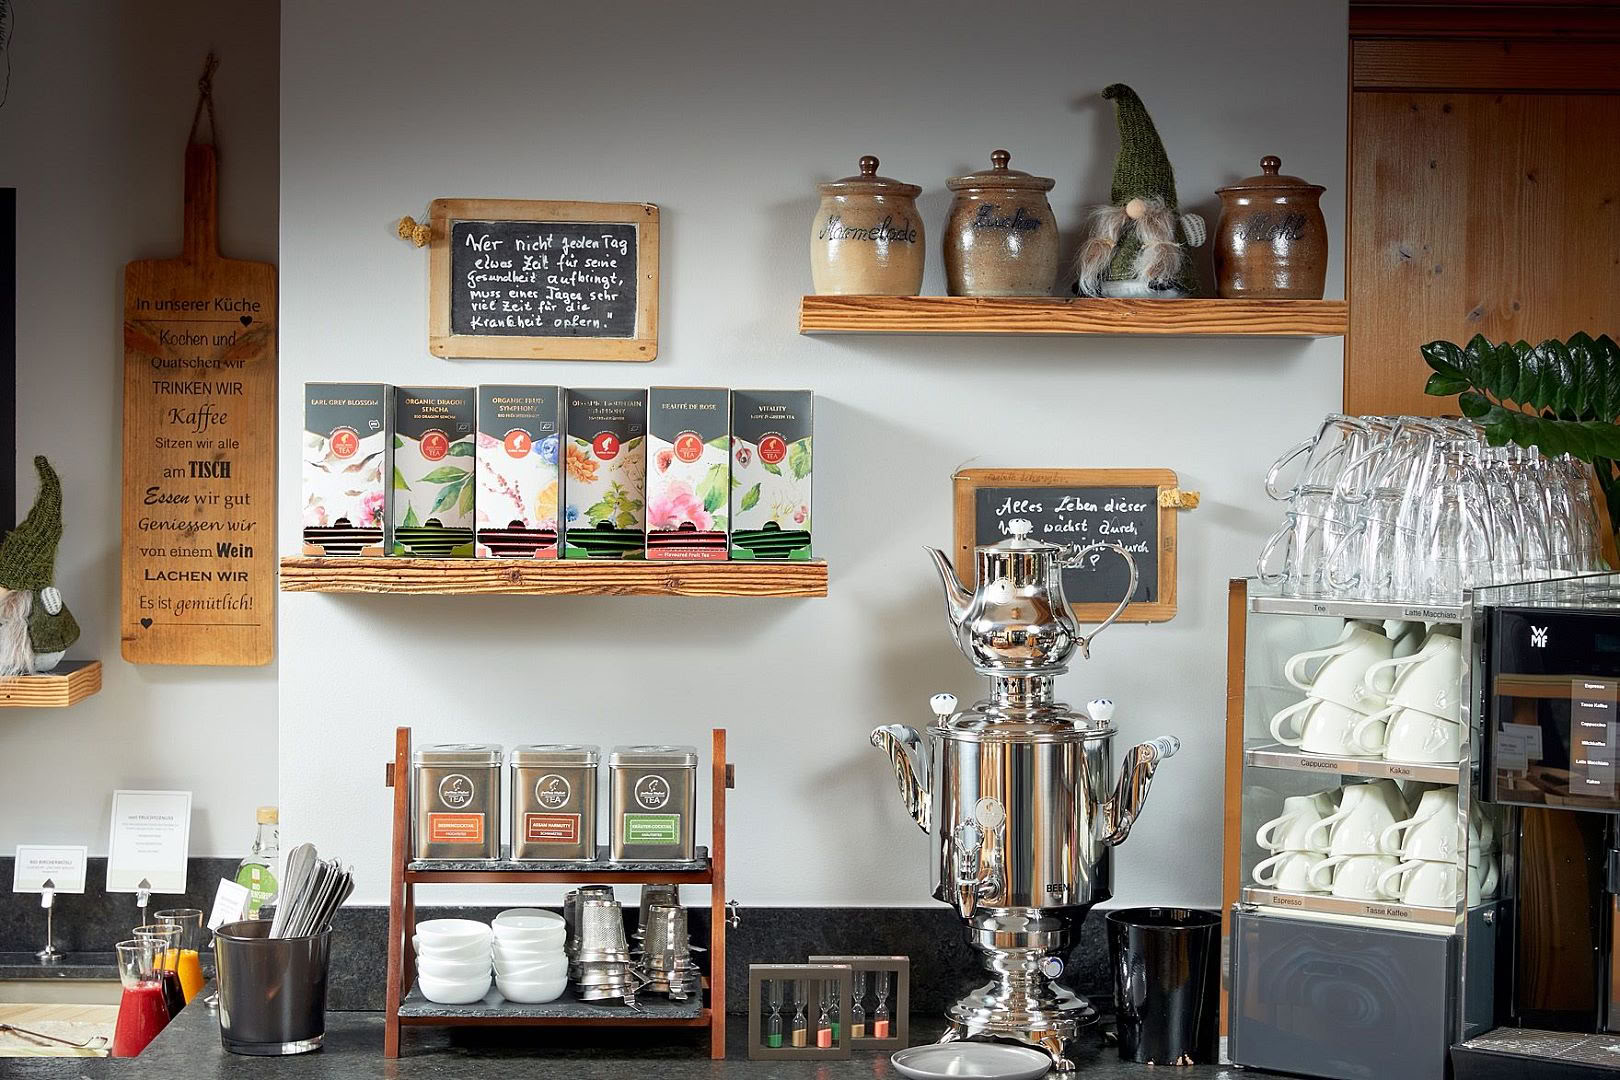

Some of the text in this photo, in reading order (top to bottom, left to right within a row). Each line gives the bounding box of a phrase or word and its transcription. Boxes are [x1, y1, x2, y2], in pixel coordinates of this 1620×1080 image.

[819, 214, 916, 244] Marmelade
[465, 234, 504, 252] Wer
[516, 234, 553, 251] nicht
[601, 234, 628, 255] Tag
[475, 253, 617, 272] etwas Zeit für seine
[470, 286, 618, 304] muss eines Tages sehr
[136, 298, 261, 312] In unserer Küche
[471, 300, 590, 314] viel Zeit für die
[159, 329, 236, 346] Kochen und
[152, 357, 246, 369] Quatschen wir
[152, 381, 243, 395] TRINKEN WIR
[168, 403, 228, 433] Kaffee
[155, 437, 239, 449] Sitzen wir alle
[163, 461, 231, 478] am TISCH
[143, 486, 251, 509] Essen wir gut
[996, 495, 1147, 516] Alles Leben dieser
[138, 517, 257, 532] Geniessen wir
[139, 542, 253, 558] von einem Wein
[144, 569, 249, 582] LACHEN WIR
[140, 593, 253, 617] Es ist gemütlich!
[1405, 609, 1457, 619] Latte Macchiato
[1300, 759, 1338, 769] Cappuccino
[1389, 767, 1410, 775] Kakao
[1273, 896, 1302, 906] Espresso
[1366, 906, 1408, 917] Tasse Kaffee
